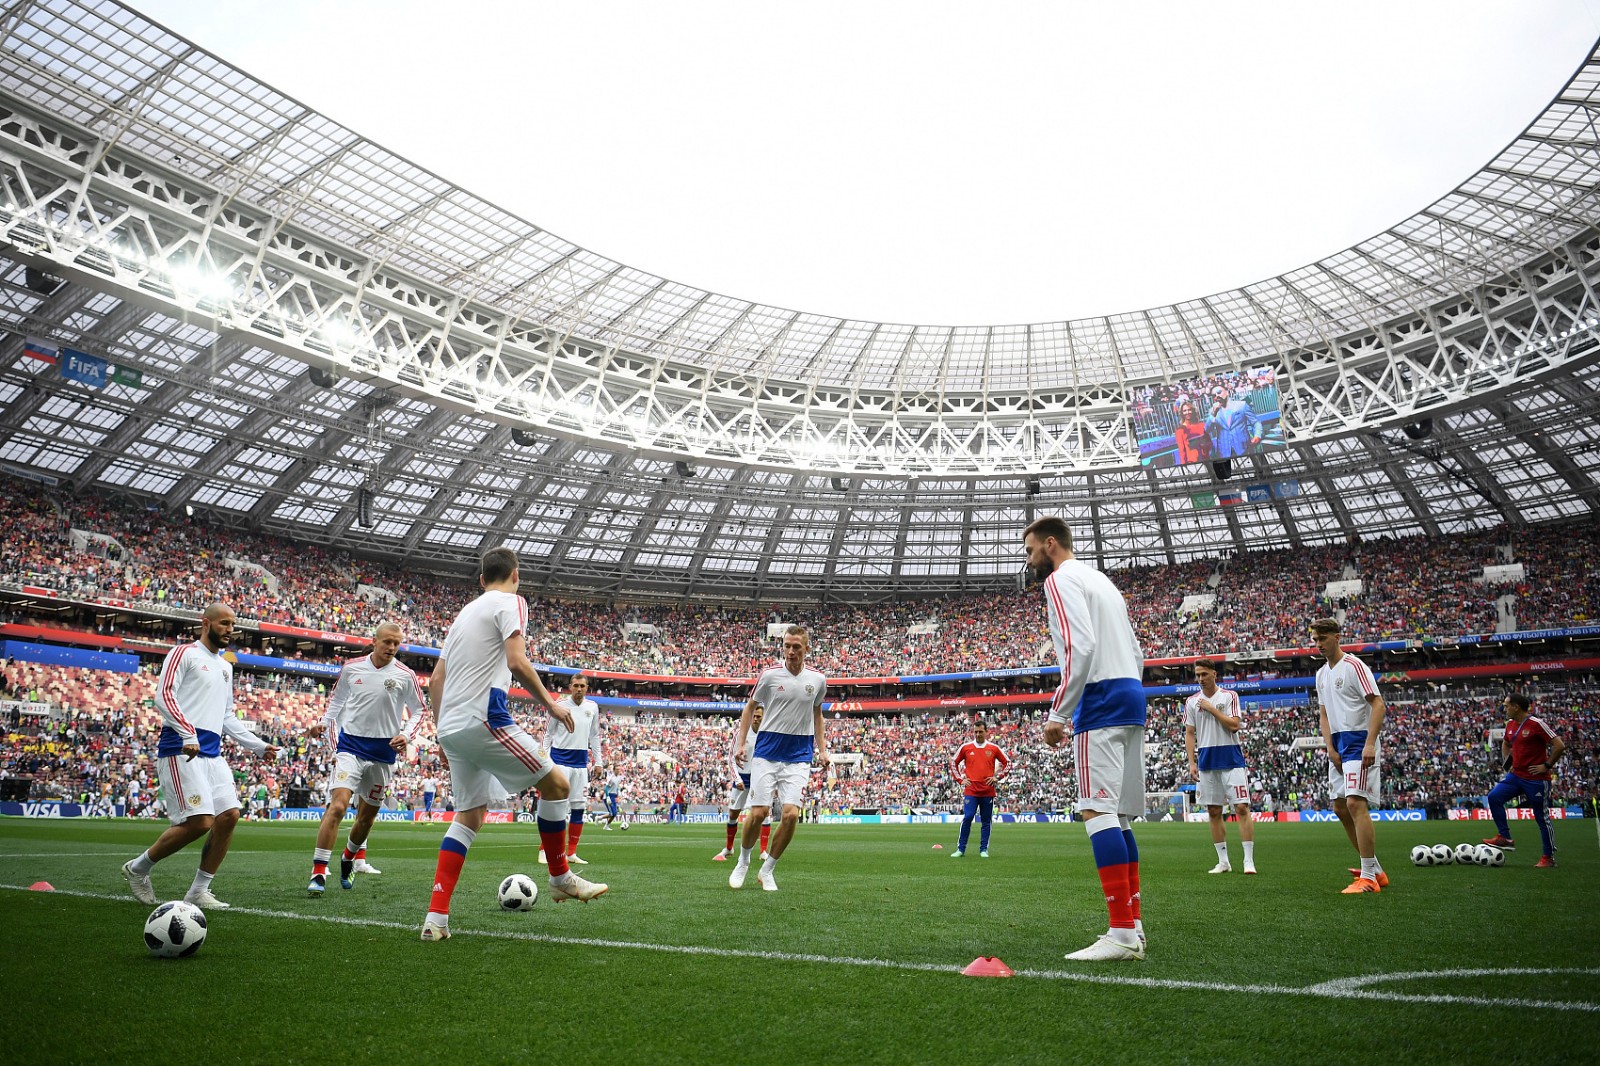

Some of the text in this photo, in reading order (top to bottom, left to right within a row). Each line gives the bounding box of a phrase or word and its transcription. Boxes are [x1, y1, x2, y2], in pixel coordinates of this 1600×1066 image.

[69, 356, 99, 378] FIFA
[1250, 489, 1267, 497] FIFA
[1345, 772, 1357, 789] 15
[1234, 785, 1248, 799] 16
[19, 802, 61, 818] VISA
[280, 810, 320, 821] 2018 FIFA
[1384, 810, 1422, 821] vivo
[518, 813, 533, 822] KIA
[611, 813, 663, 824] ATAR AIRWAYS
[1013, 814, 1037, 823] VISA
[1046, 814, 1071, 823] VISA
[1305, 810, 1340, 822] vivo
